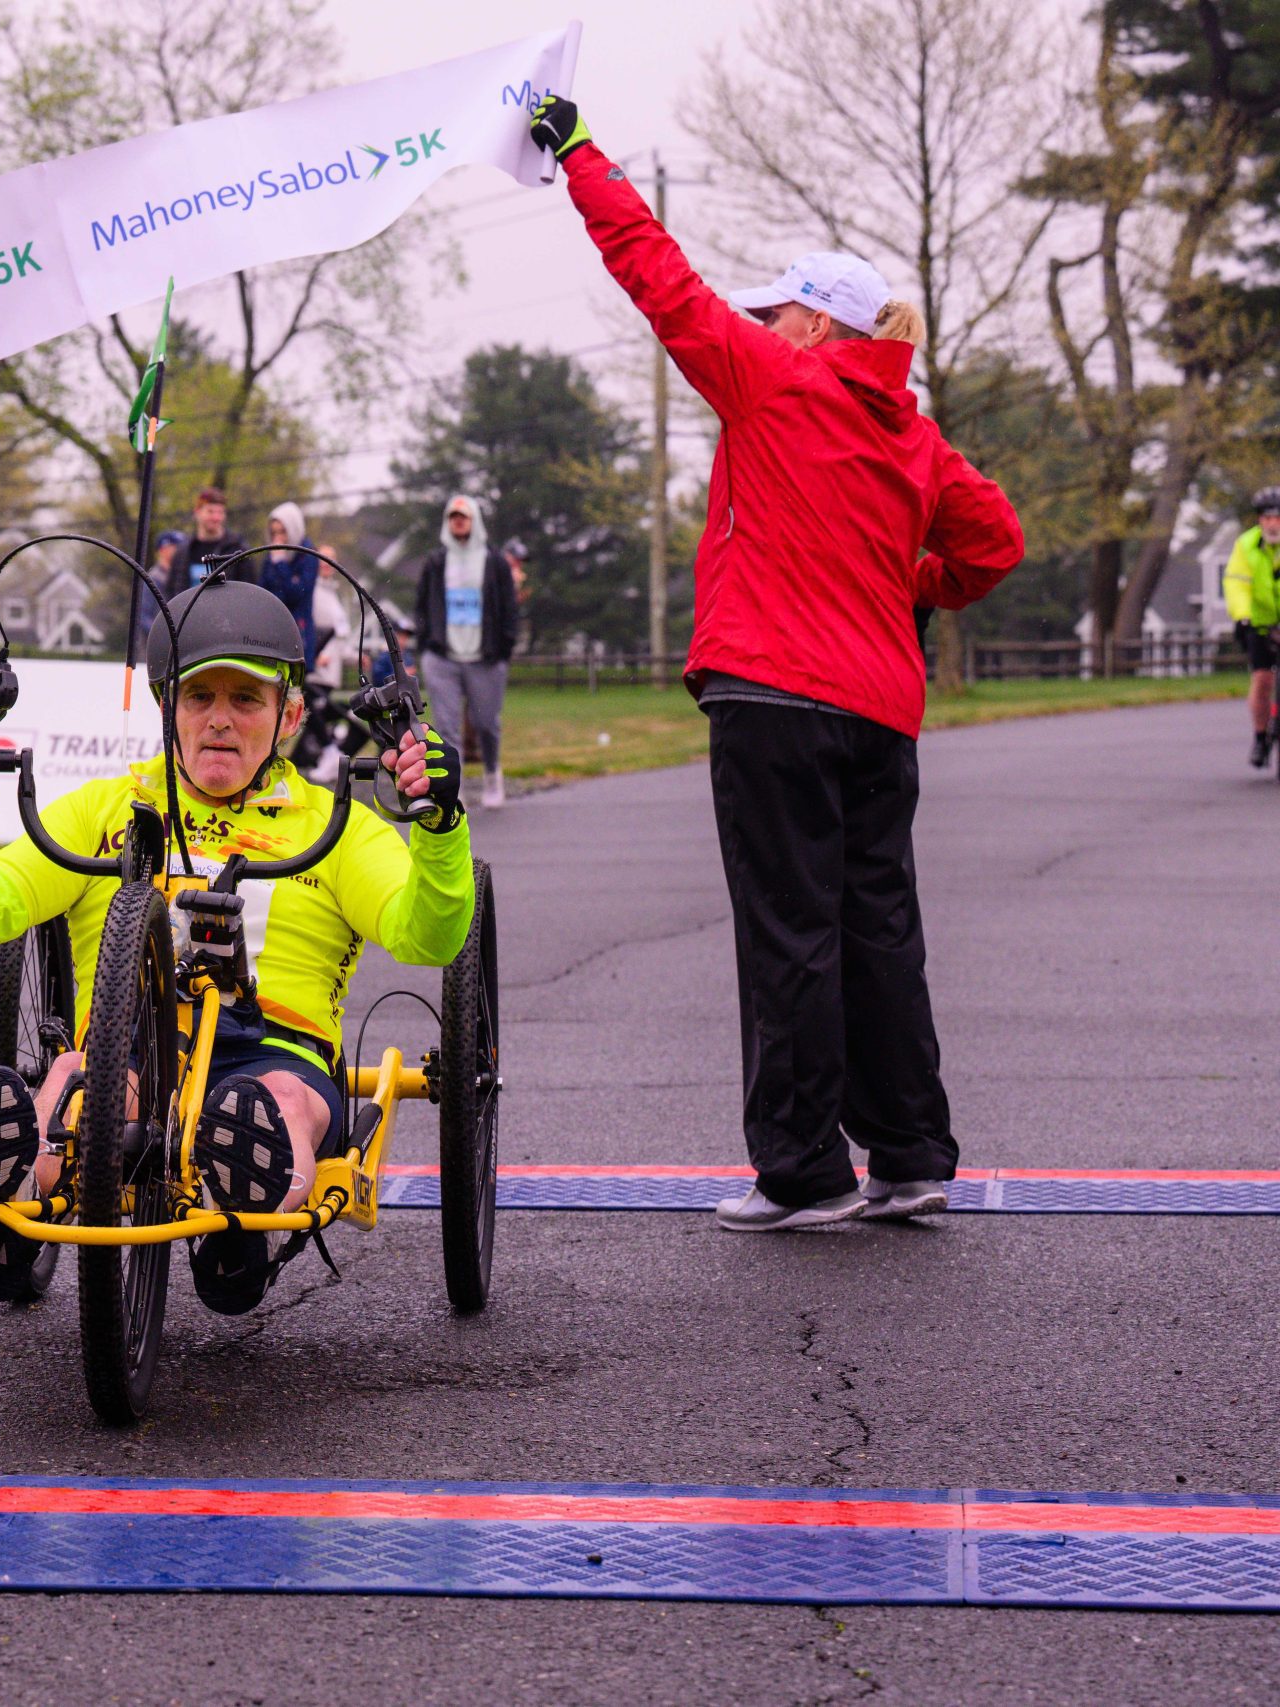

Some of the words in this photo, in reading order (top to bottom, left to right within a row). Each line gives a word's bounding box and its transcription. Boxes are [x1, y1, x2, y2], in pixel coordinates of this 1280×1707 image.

[90, 151, 360, 251] MahoneySabol
[394, 128, 447, 167] 5K
[47, 733, 164, 760] TRAVEL
